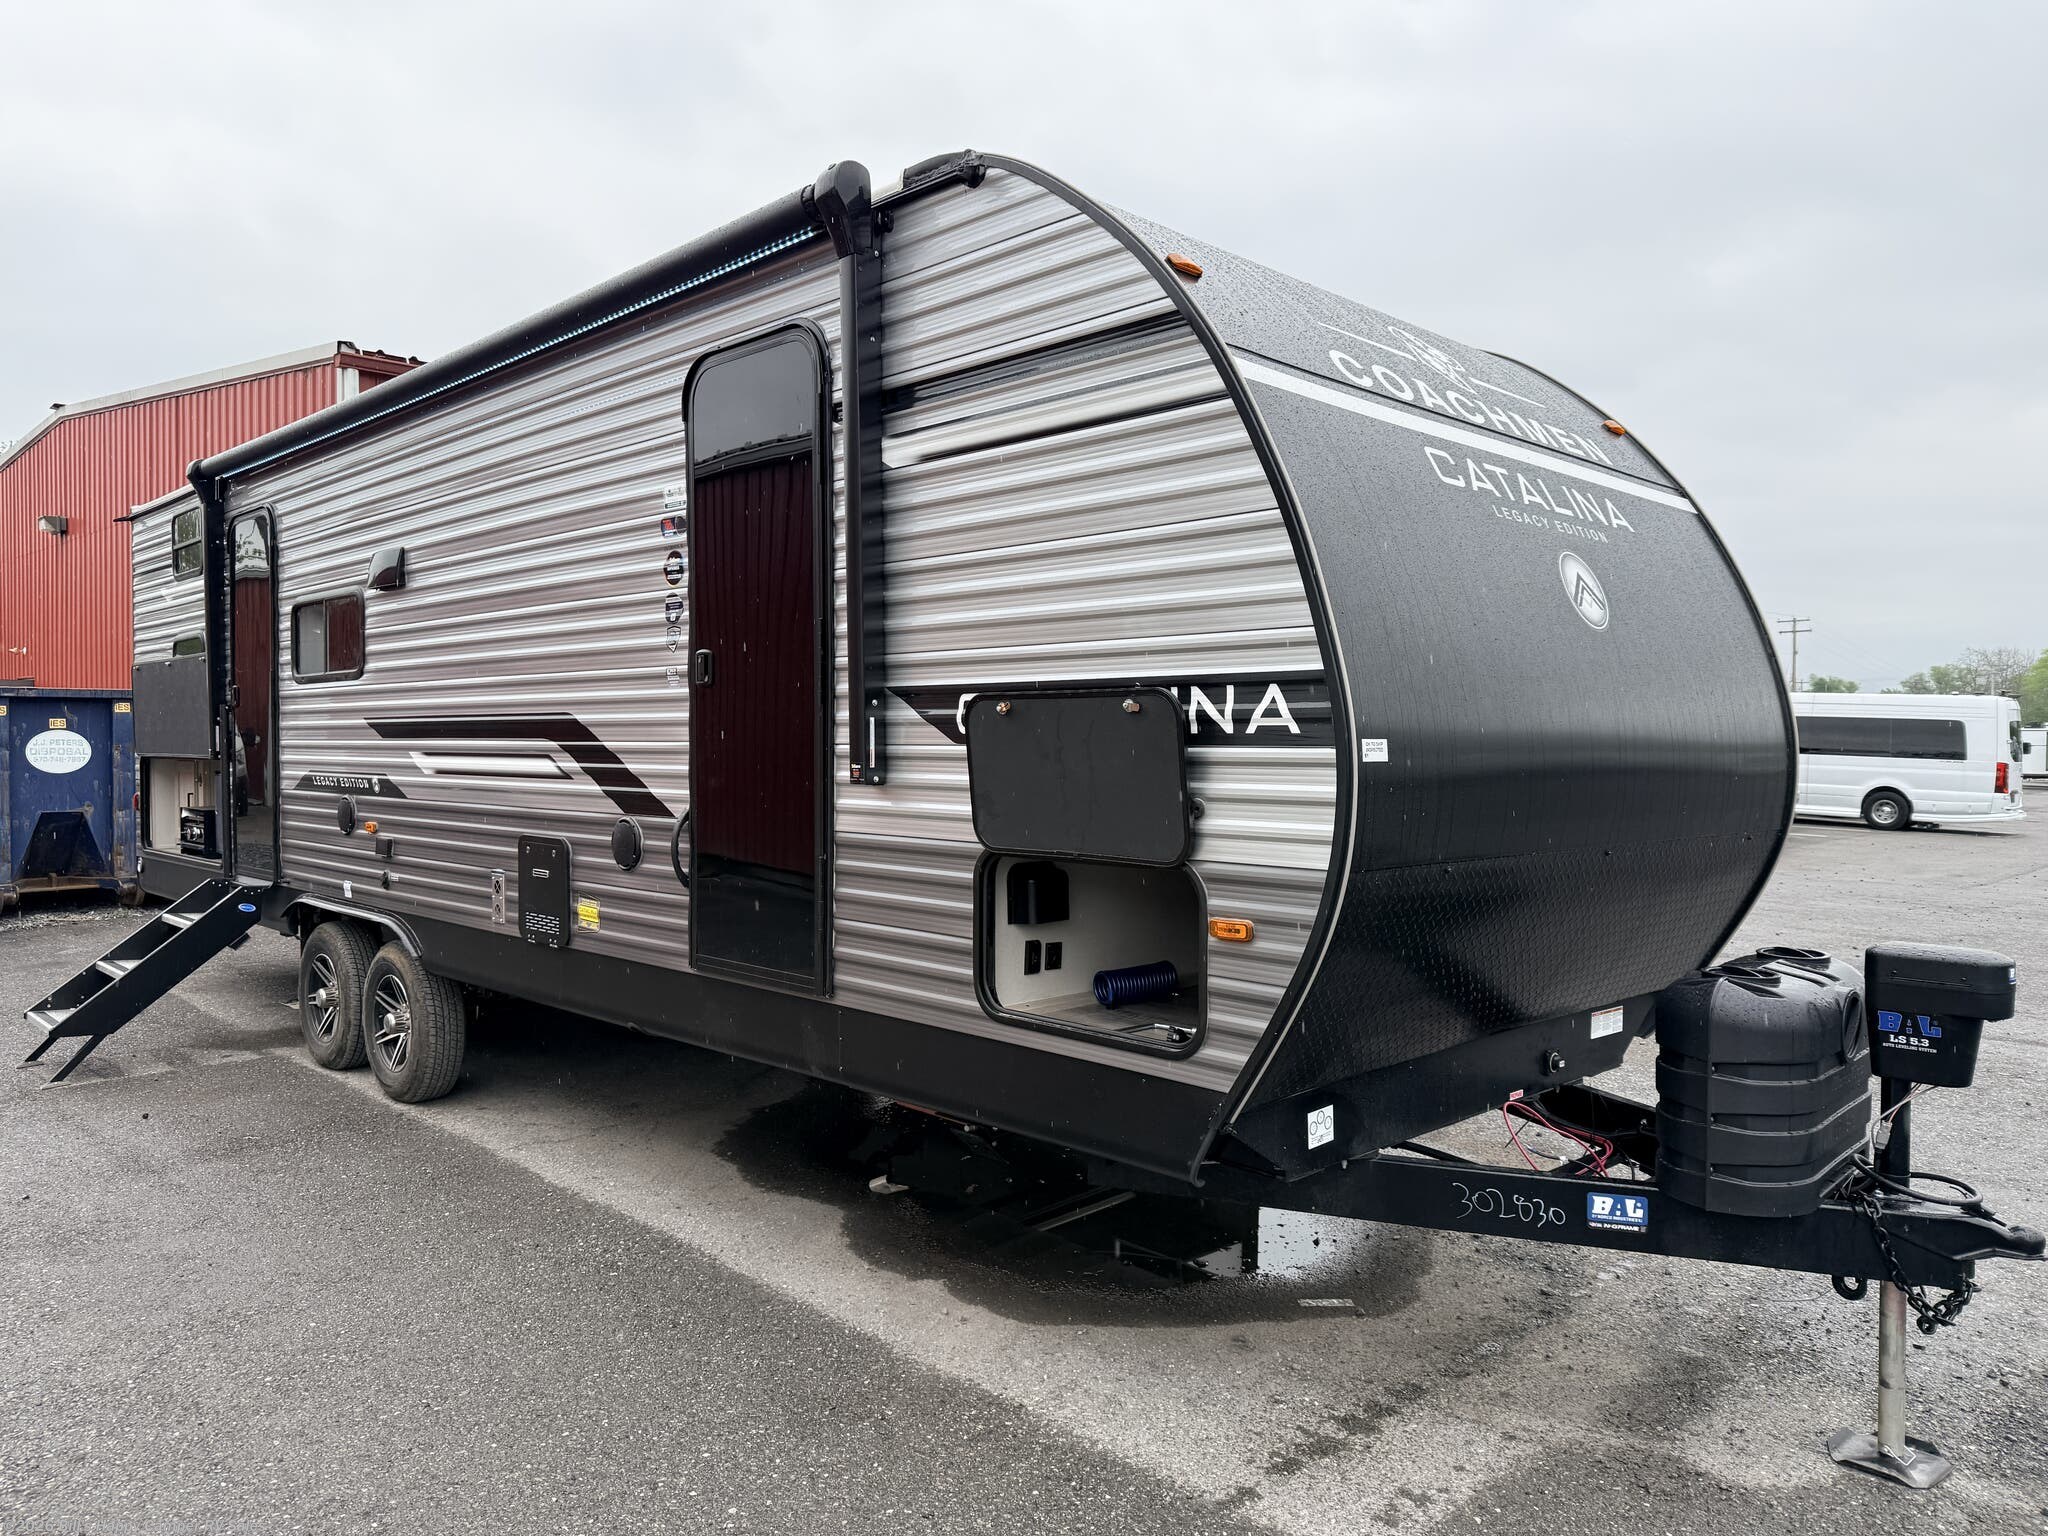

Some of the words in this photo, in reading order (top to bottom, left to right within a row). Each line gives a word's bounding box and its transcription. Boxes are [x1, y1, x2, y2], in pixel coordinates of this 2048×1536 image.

[1329, 349, 1614, 465] COACHMEN
[1424, 446, 1635, 533] CATALINA
[1492, 505, 1550, 529] LEGACY
[1555, 520, 1609, 543] EDITION
[50, 719, 66, 728] IES
[29, 747, 89, 756] DISPOSAL
[312, 775, 338, 787] LEGACY
[340, 777, 370, 789] EDITION
[1889, 1034, 1907, 1044] LS
[1910, 1037, 1930, 1047] 5.3
[1452, 1182, 1566, 1229] 302830
